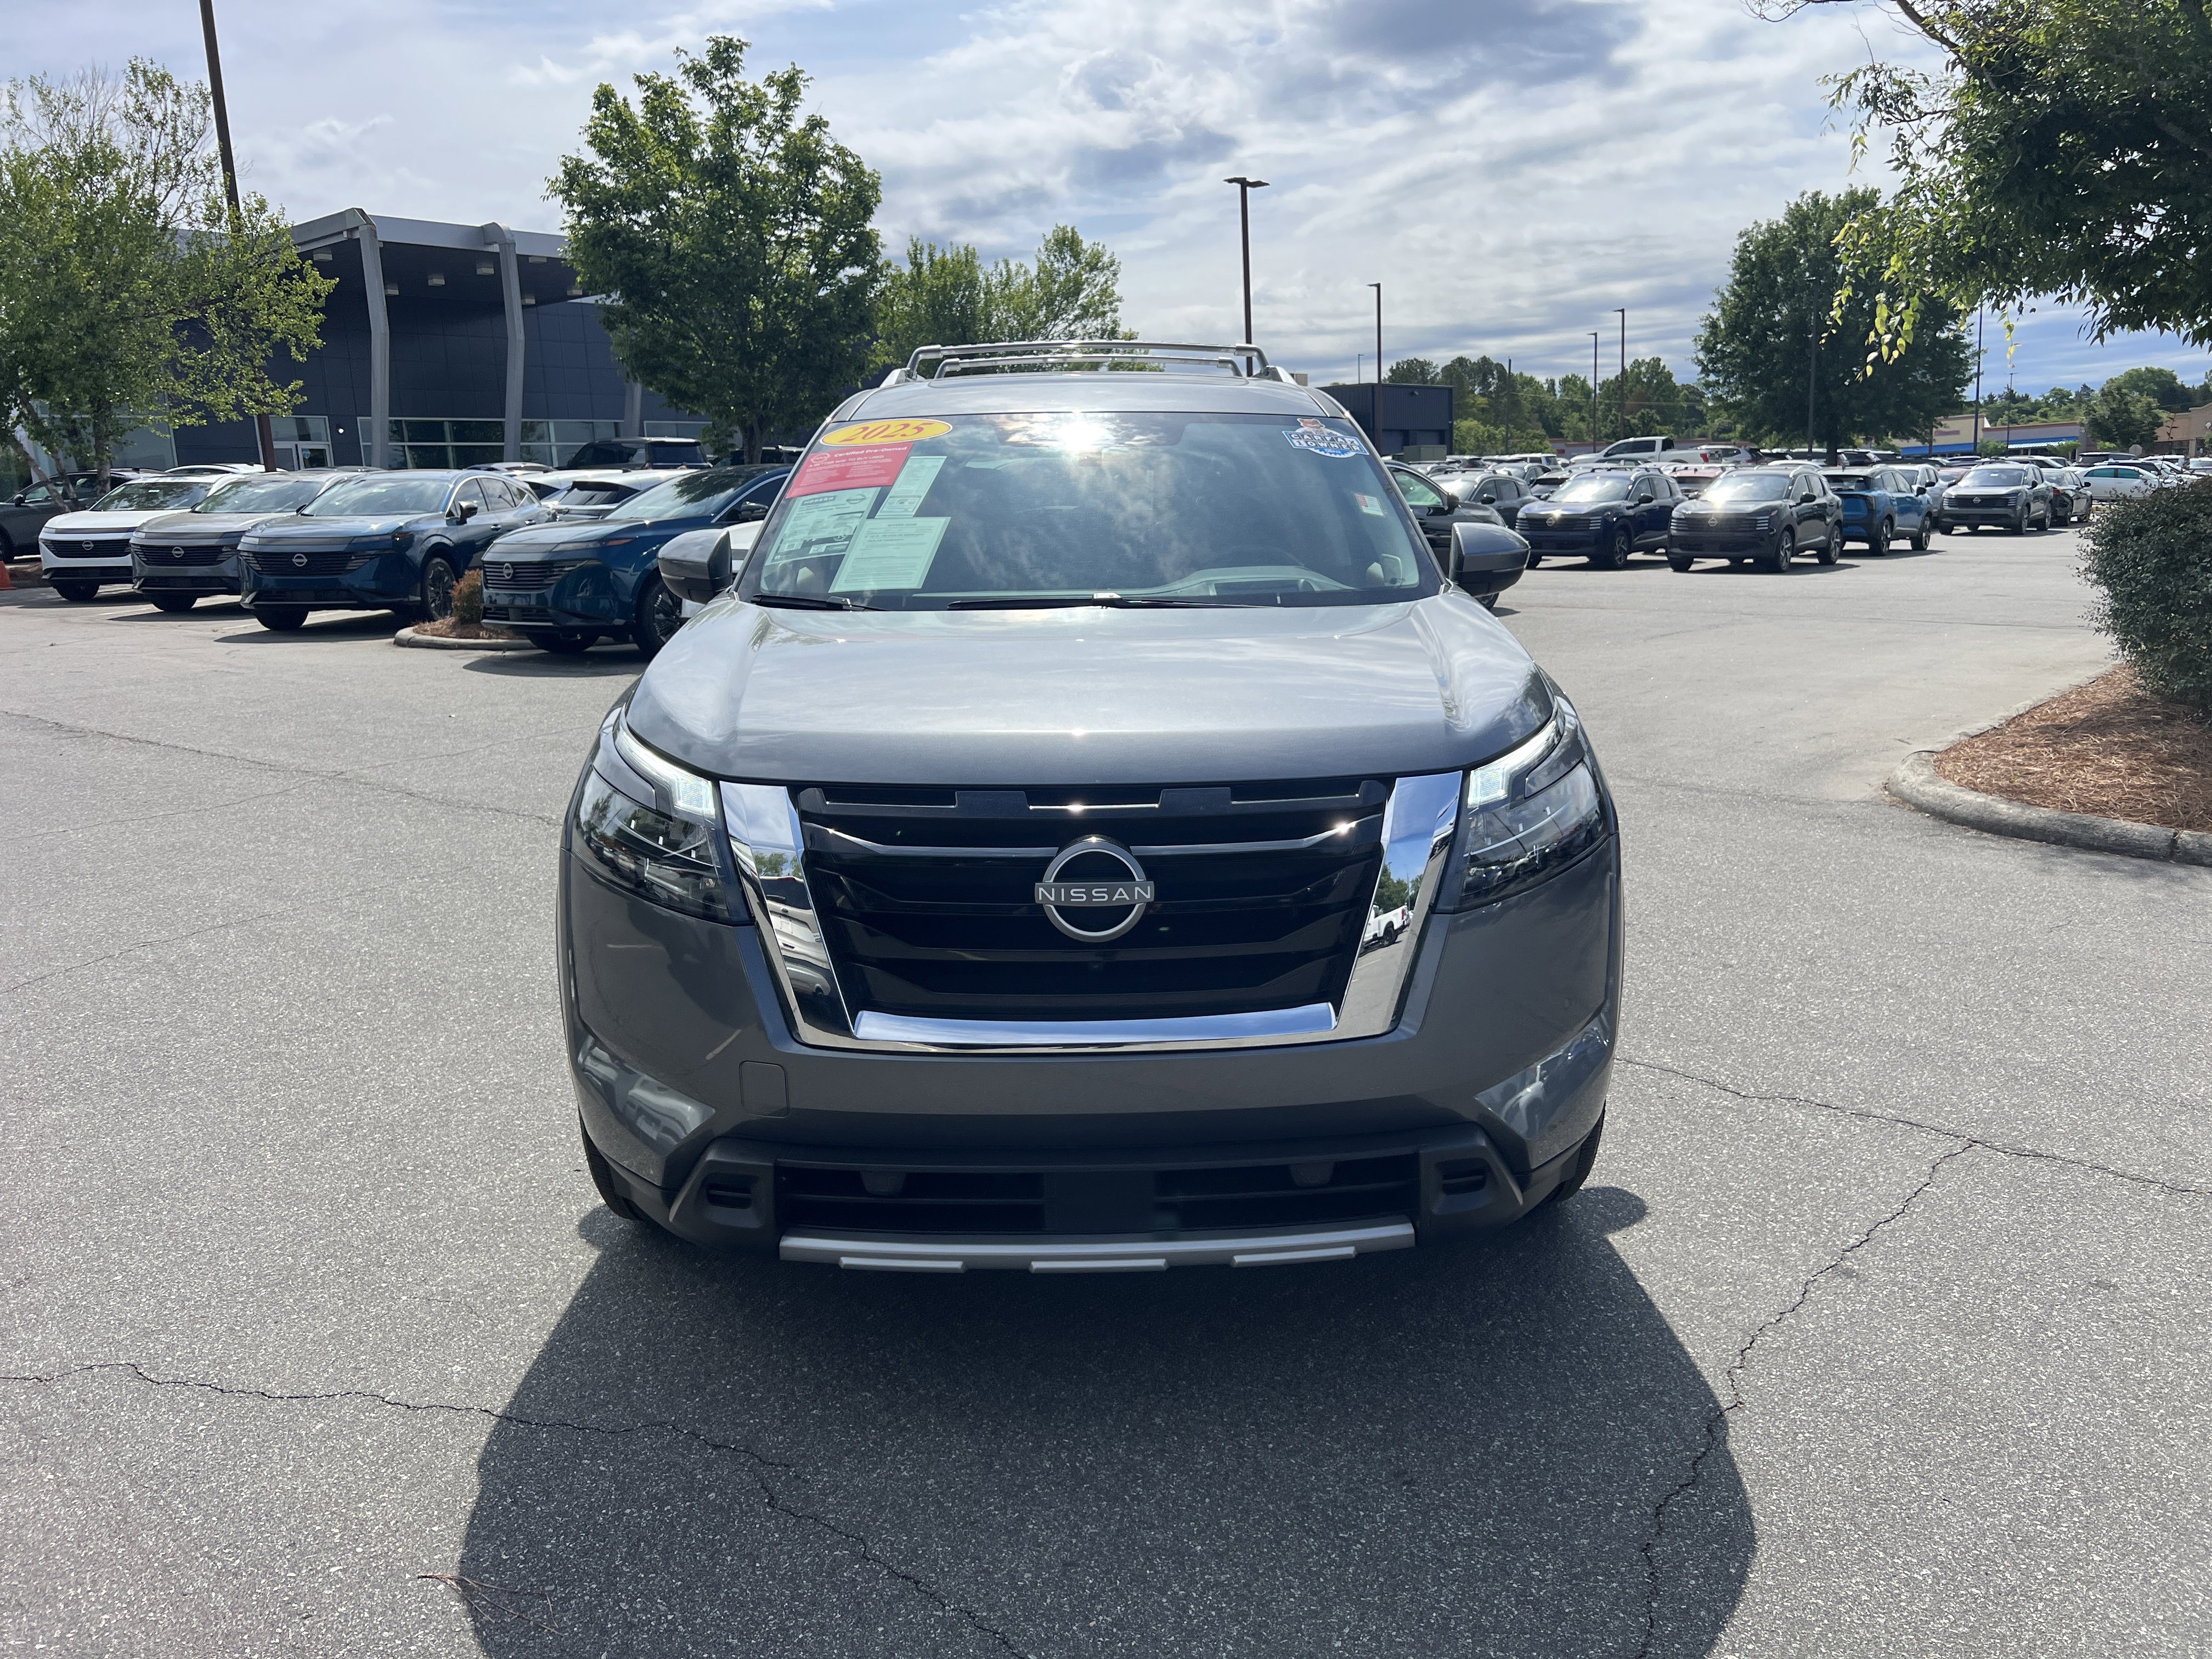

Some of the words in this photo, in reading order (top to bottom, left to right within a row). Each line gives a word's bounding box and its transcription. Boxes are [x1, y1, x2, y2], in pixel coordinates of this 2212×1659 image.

[838, 422, 934, 443] 2025
[1290, 434, 1359, 444] CARFAX
[1306, 441, 1362, 452] OWNER
[1038, 885, 1151, 902] NISSAN
